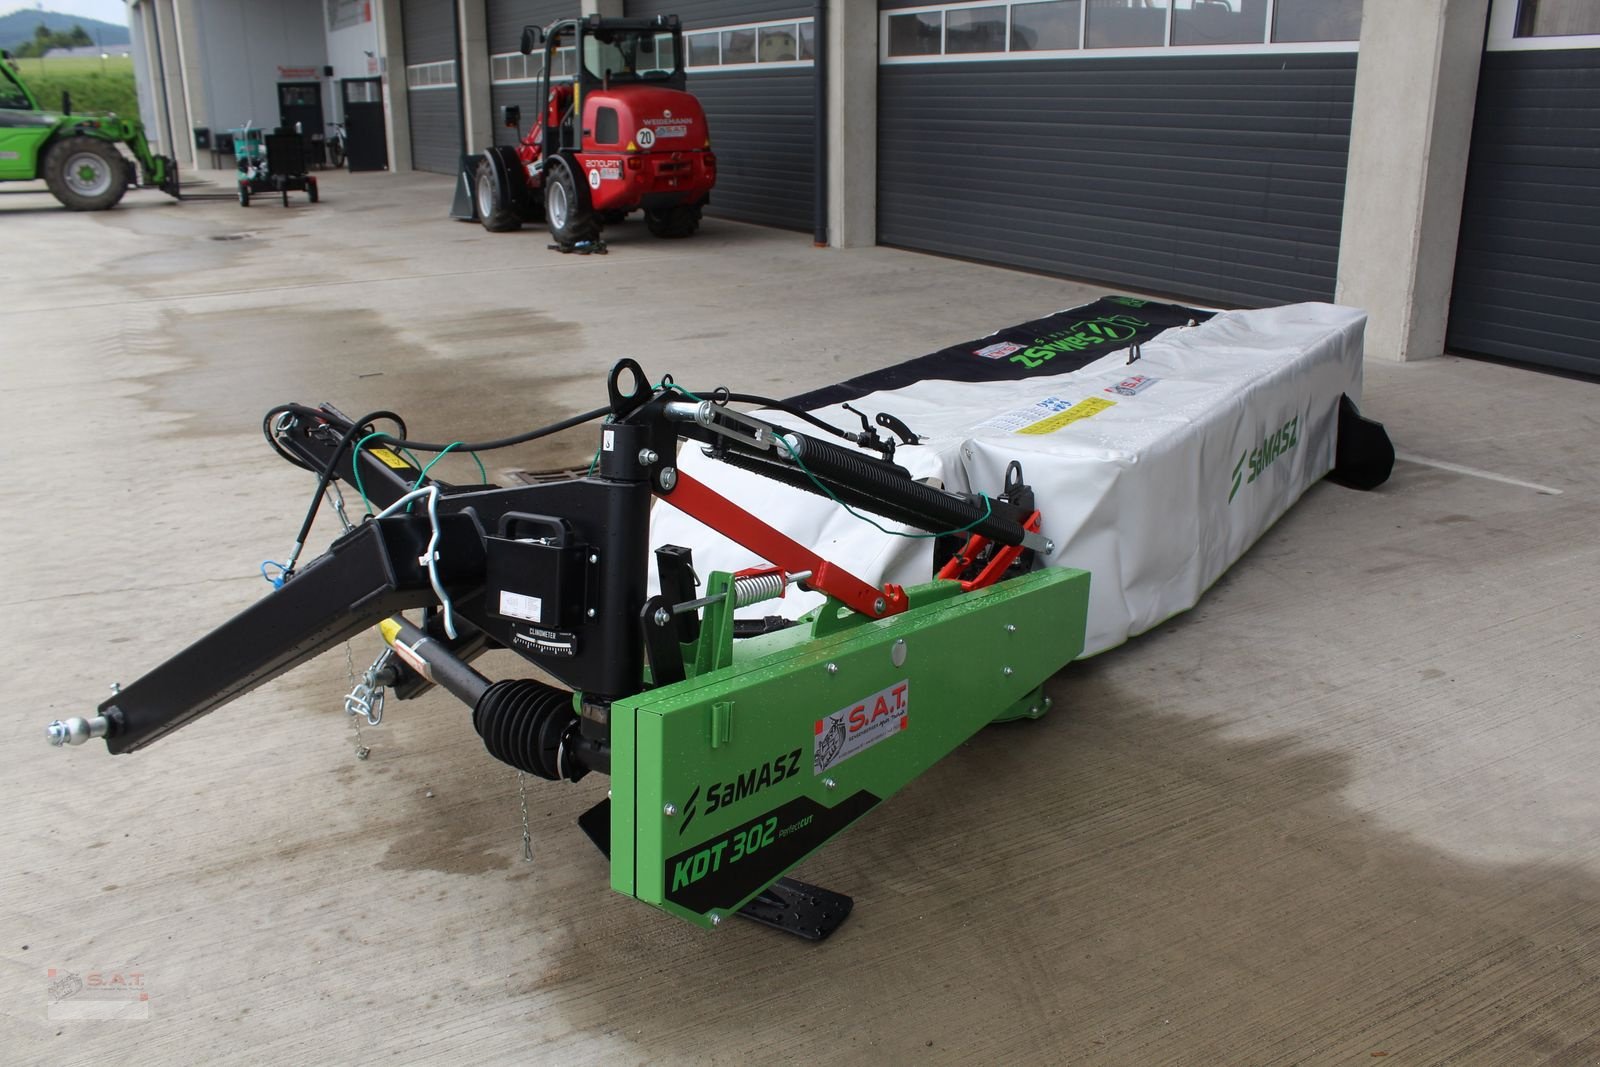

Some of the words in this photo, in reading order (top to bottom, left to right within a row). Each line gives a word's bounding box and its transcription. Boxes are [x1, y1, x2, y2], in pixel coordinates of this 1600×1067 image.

[640, 131, 652, 144] 20
[643, 118, 692, 126] WEIDEMANN
[1247, 415, 1299, 485] SaMASZ
[529, 627, 557, 639] CLINOMETER
[848, 683, 907, 733] S.A.T.
[703, 748, 803, 817] SaMASZ
[671, 840, 730, 893] KDT
[729, 816, 778, 864] 302
